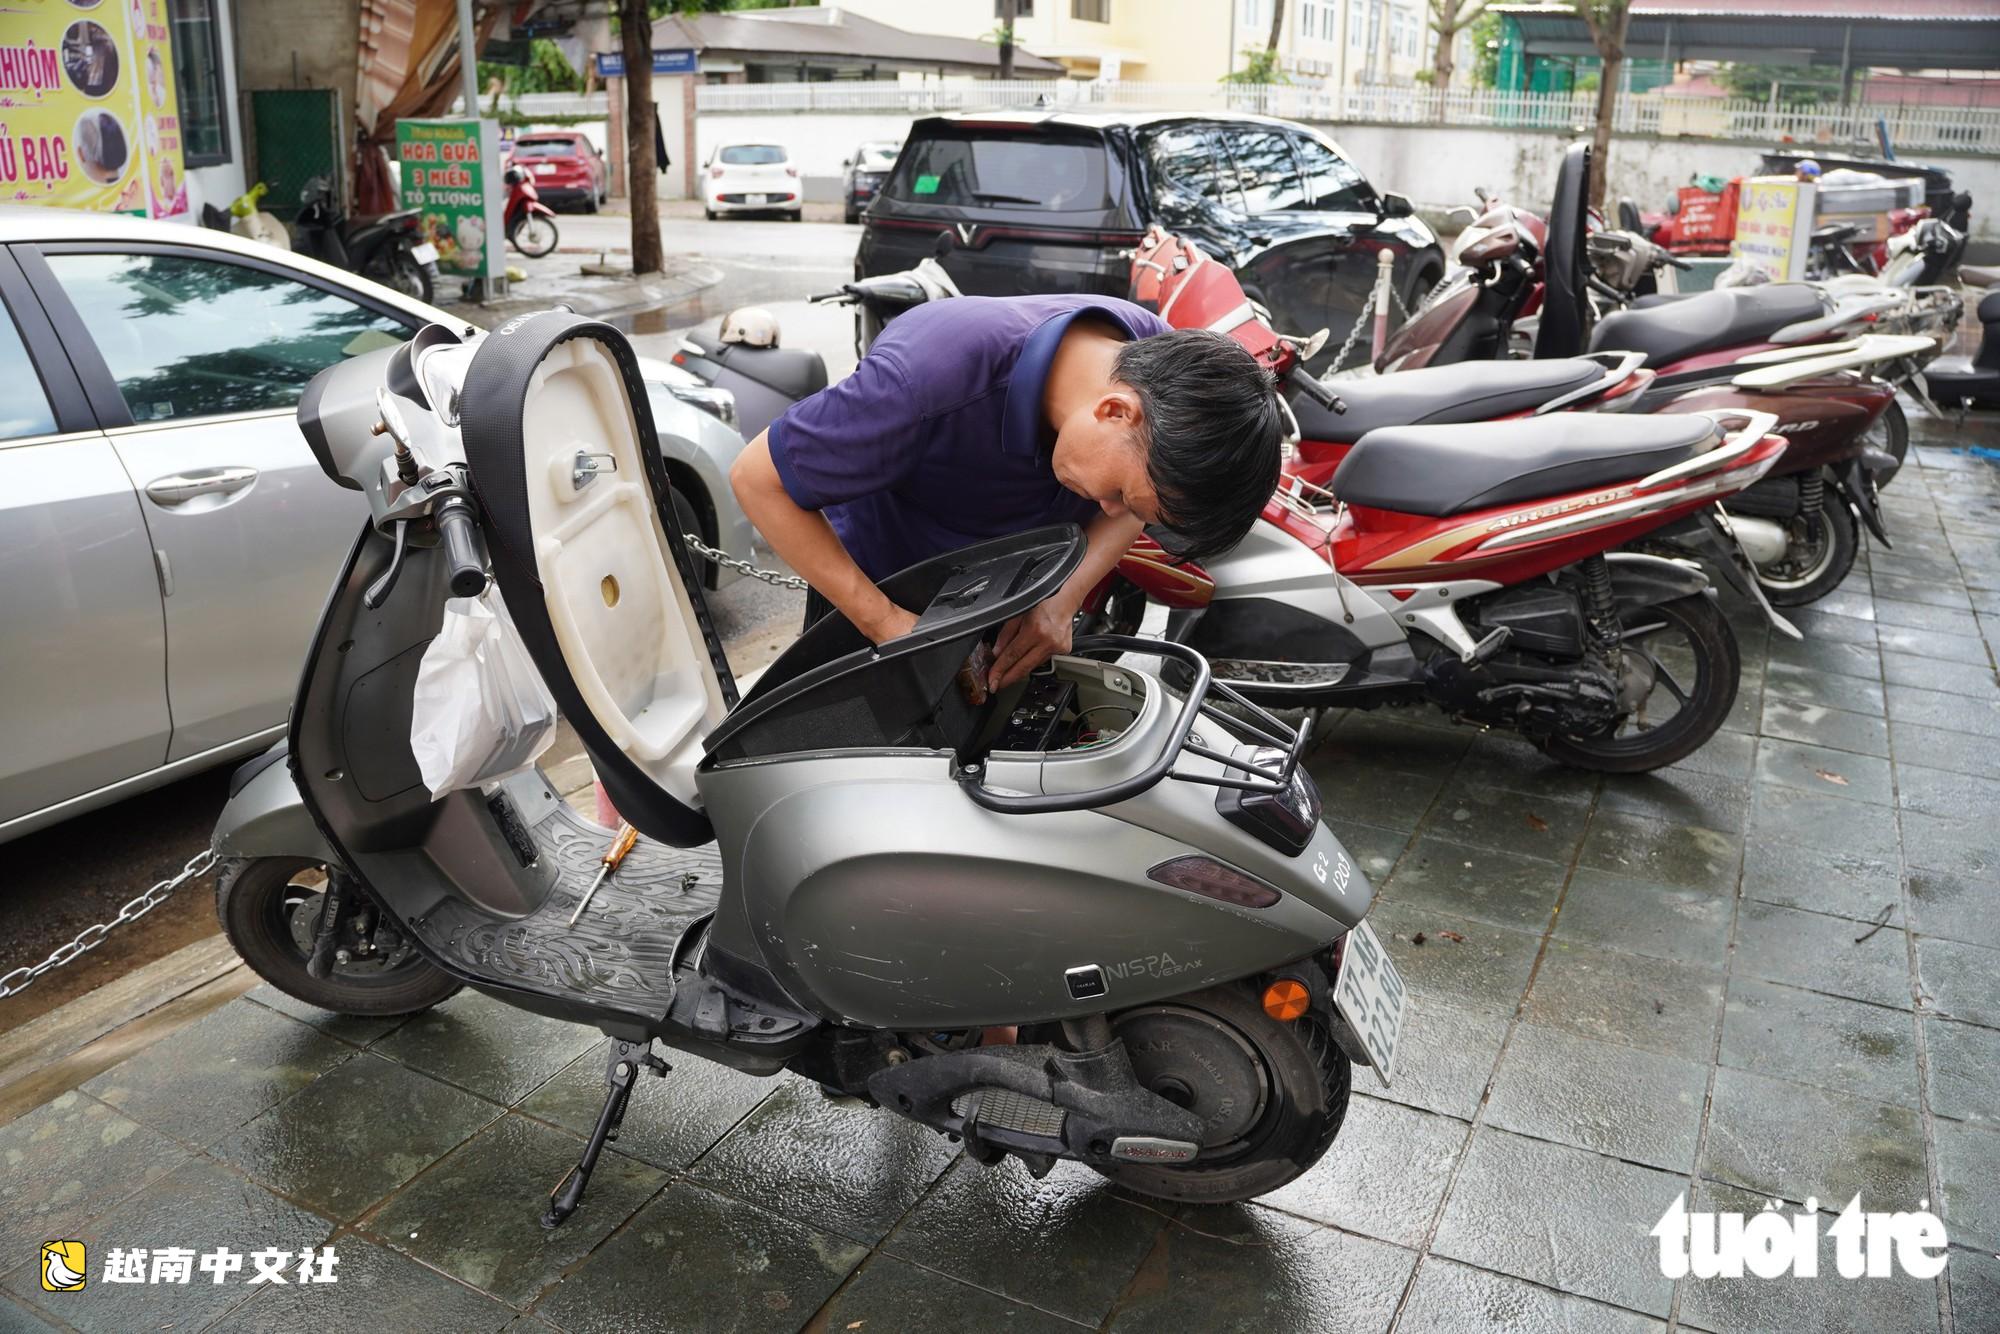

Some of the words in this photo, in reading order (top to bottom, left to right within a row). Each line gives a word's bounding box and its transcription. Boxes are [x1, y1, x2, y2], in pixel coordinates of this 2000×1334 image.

[0, 39, 60, 98] HUỘM
[0, 123, 17, 182] Ủ
[22, 136, 68, 190] BẠC
[401, 143, 437, 161] HOA
[413, 168, 425, 187] 3
[1106, 952, 1176, 981] NISPA
